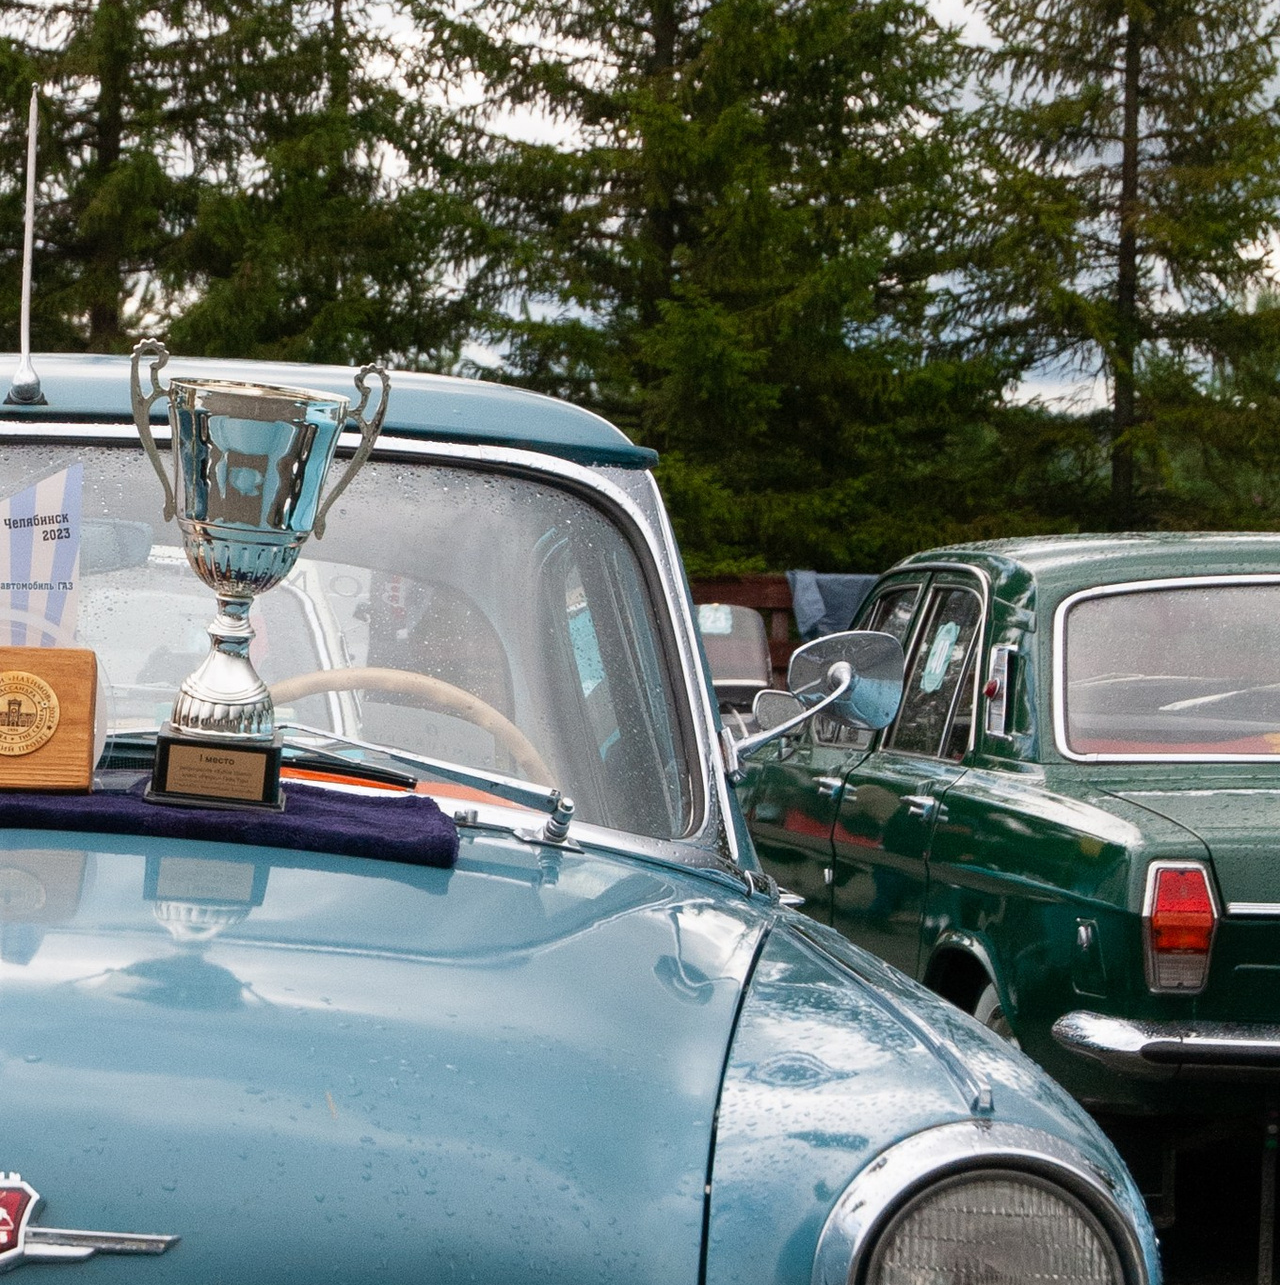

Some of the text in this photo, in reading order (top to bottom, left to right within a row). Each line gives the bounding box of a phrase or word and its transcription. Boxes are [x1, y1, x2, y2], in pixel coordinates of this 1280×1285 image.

[3, 513, 69, 530] Челябинск
[42, 527, 71, 542] 2023
[0, 581, 55, 591] автомобиль
[57, 581, 74, 591] ГАЗ
[204, 756, 235, 766] место
